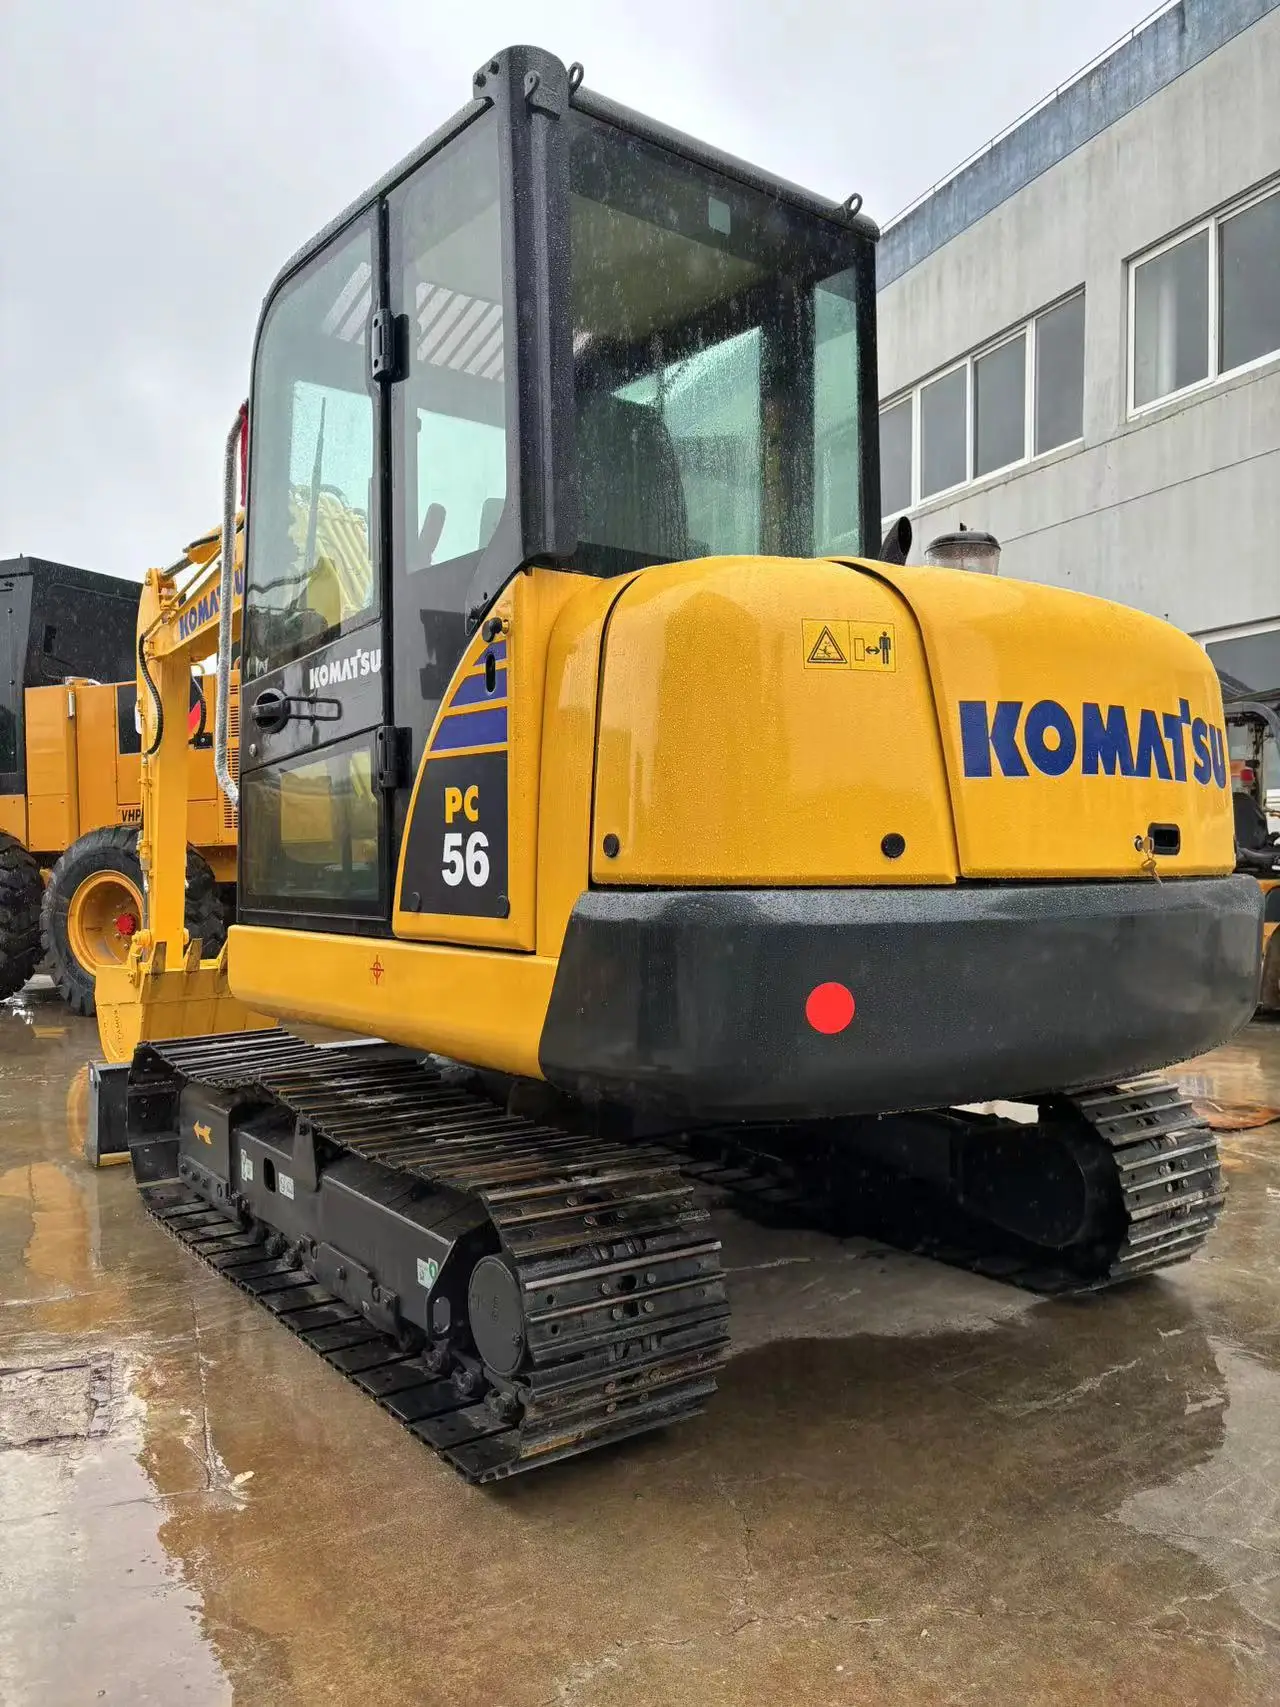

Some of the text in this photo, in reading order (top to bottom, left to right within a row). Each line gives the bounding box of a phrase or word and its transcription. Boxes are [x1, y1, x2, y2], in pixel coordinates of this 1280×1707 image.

[179, 570, 243, 641] KOMAU
[309, 648, 382, 690] KOMATSU
[958, 697, 1227, 789] KOMATSU
[444, 785, 480, 823] PC
[441, 831, 490, 887] 56
